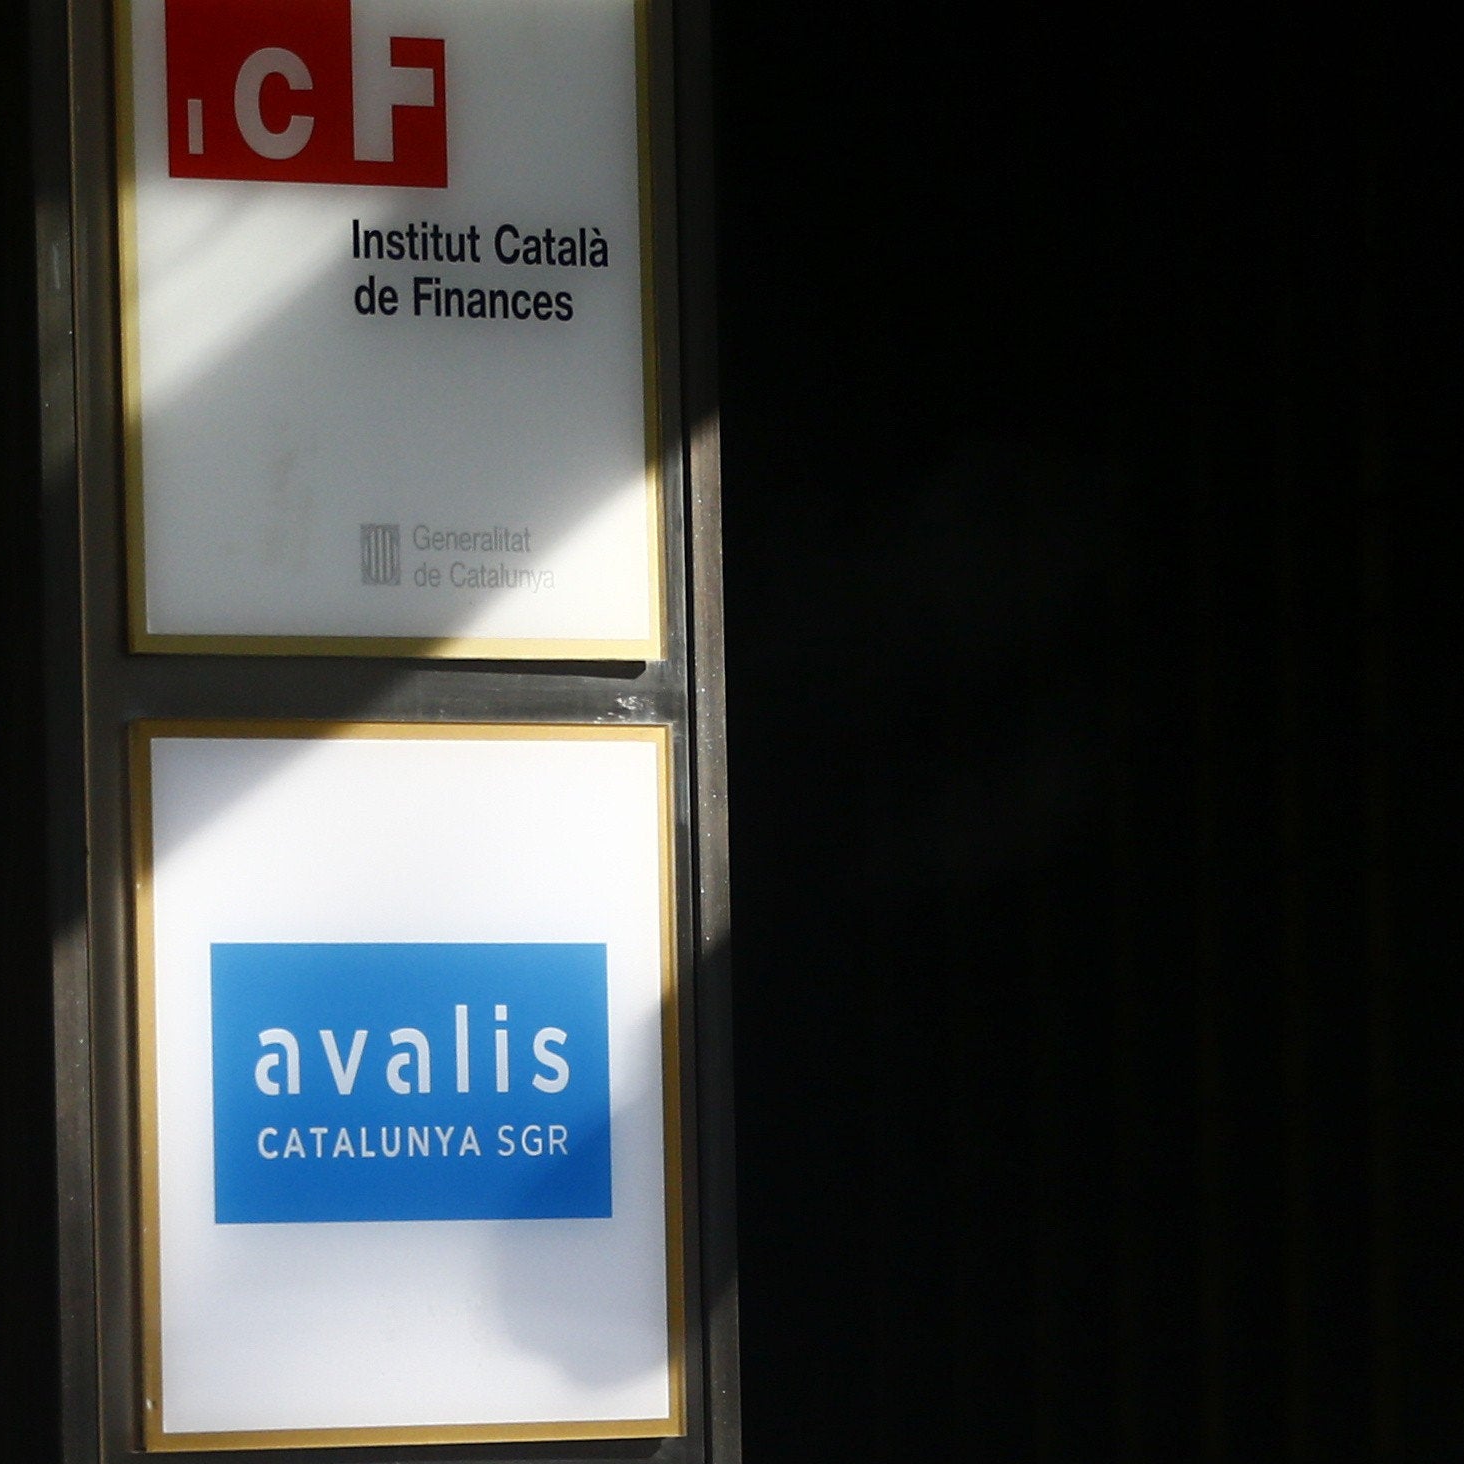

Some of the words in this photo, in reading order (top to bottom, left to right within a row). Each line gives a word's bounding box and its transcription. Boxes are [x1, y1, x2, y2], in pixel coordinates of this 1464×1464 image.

[352, 219, 481, 264] Institut
[494, 223, 609, 268] Català
[354, 275, 399, 316] de
[413, 276, 574, 322] Finances
[413, 524, 532, 552] Generalitat
[414, 562, 441, 588] de
[450, 561, 555, 594] Catalunya
[254, 1003, 570, 1096] avalis
[257, 1125, 481, 1159] CATALUNYA
[498, 1124, 568, 1156] SGR
